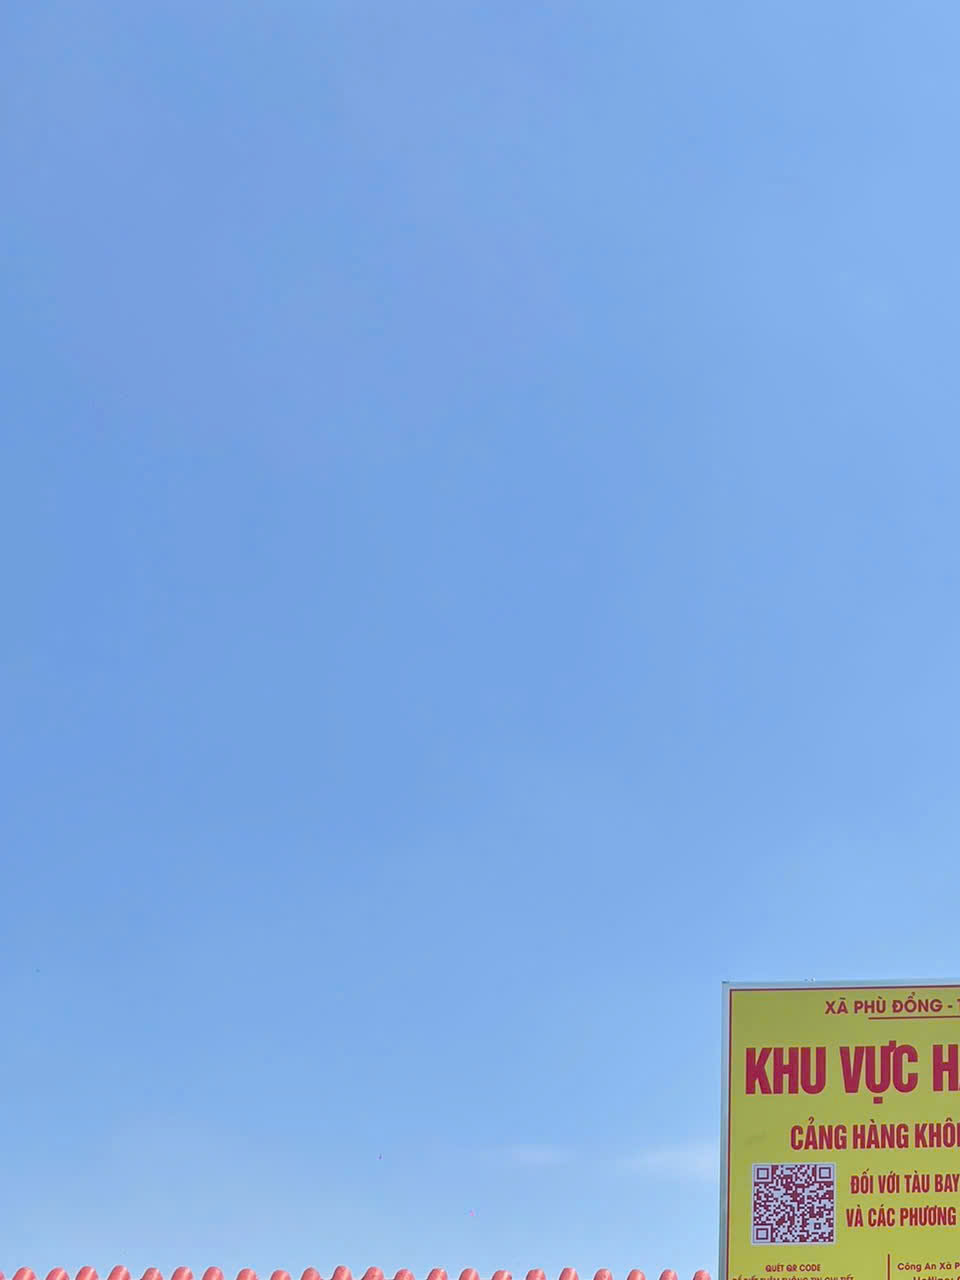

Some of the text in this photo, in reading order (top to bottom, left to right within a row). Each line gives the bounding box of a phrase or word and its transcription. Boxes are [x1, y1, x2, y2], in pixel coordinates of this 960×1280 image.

[825, 998, 848, 1014] XÃ
[854, 996, 886, 1013] PHÙ
[892, 992, 942, 1013] ĐỔNG
[746, 1047, 826, 1094] KHU
[840, 1040, 918, 1104] VỰC
[791, 1117, 846, 1150] CẢNG
[853, 1120, 908, 1149] HÀNG
[851, 1169, 873, 1194] ĐỐI
[878, 1171, 899, 1193] VỚI
[905, 1171, 930, 1193] TÀU
[935, 1174, 960, 1192] BAY
[846, 1205, 863, 1227] VÀ
[868, 1204, 895, 1227] CÁC
[900, 1206, 956, 1226] PHƯƠNG
[786, 1263, 798, 1273] QR
[800, 1263, 821, 1272] CODE
[925, 1262, 937, 1271] An
